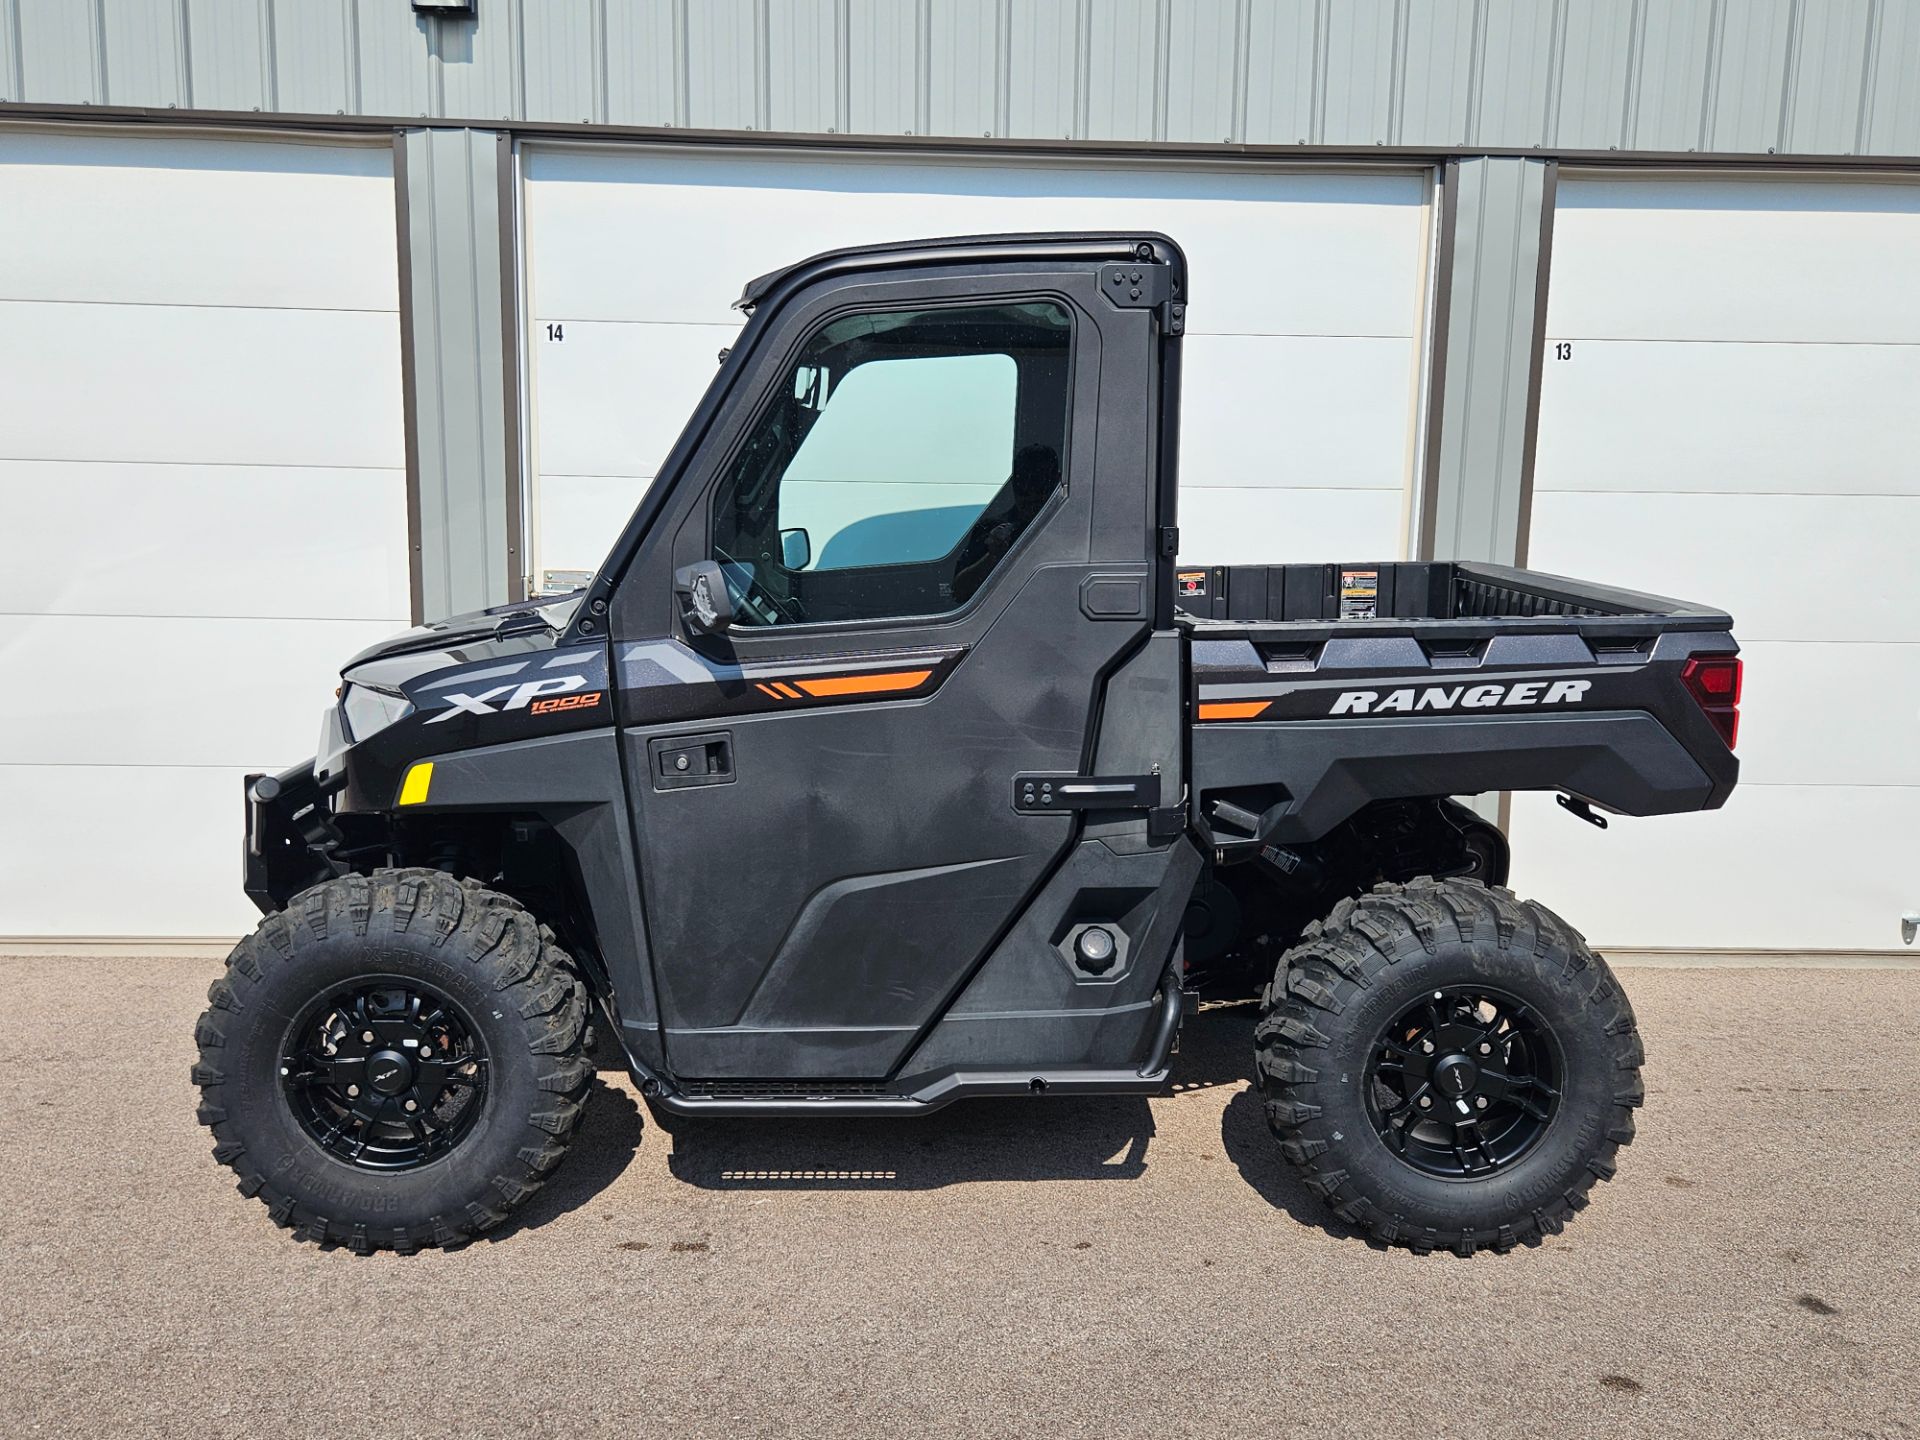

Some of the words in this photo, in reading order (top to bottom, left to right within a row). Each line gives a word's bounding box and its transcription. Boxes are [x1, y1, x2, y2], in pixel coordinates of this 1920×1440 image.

[546, 323, 564, 341] 14
[1555, 342, 1571, 360] 13
[422, 674, 588, 725] XP
[531, 692, 601, 711] 1000
[1328, 680, 1592, 715] RANGER
